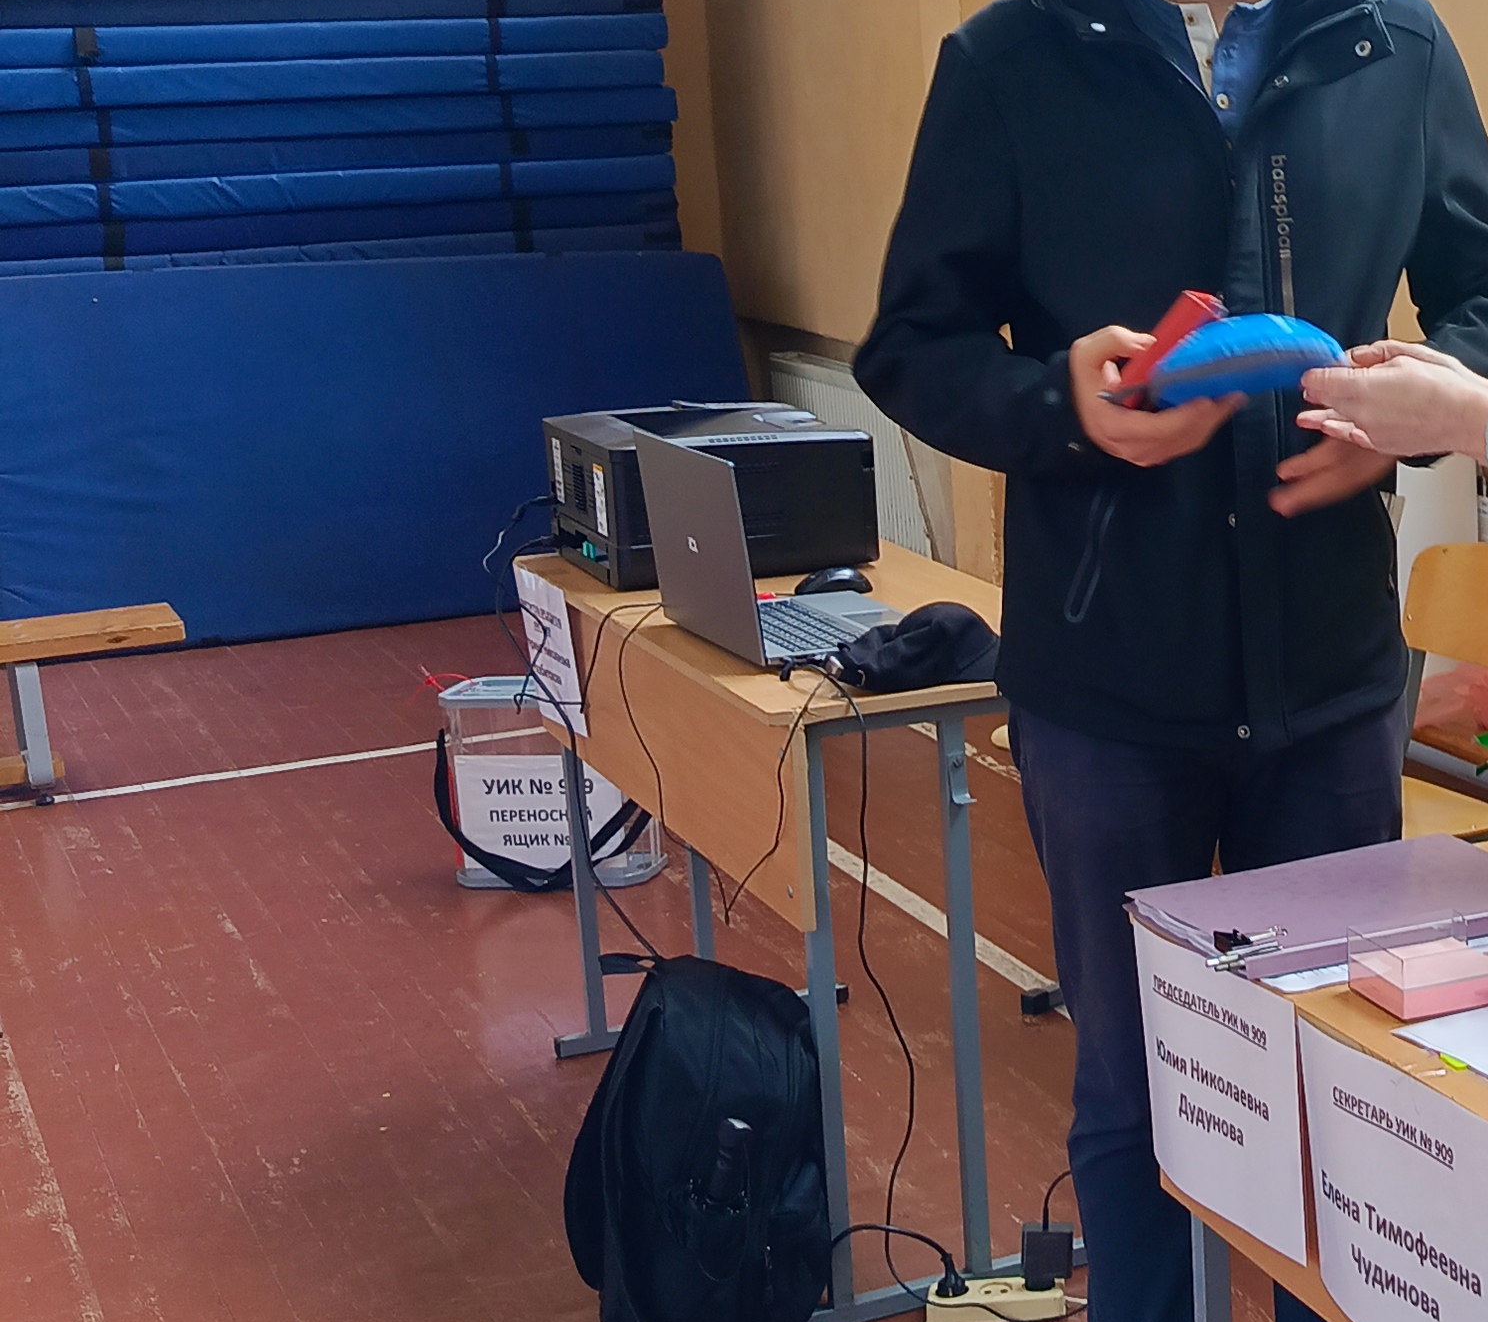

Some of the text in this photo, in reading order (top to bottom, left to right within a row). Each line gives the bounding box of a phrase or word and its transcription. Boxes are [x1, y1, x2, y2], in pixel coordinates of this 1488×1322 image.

[482, 778, 594, 795] УИК № 99
[490, 806, 593, 823] ПЕРЕНОСНЙ
[503, 834, 551, 849] ЯЩИК
[1153, 974, 1220, 1020] ПРЕДСЕДАТЕЛЬ
[1221, 1007, 1239, 1030] УИК
[1251, 1024, 1268, 1047] 909
[1156, 1036, 1270, 1122] Юлия Николаевна
[1178, 1092, 1244, 1147] Дудунова
[1332, 1085, 1454, 1165] СЕКРЕТАРЬ УИК № 909
[1321, 1169, 1482, 1297] Елена Тимофеевна
[1351, 1242, 1440, 1322] Чудинова
